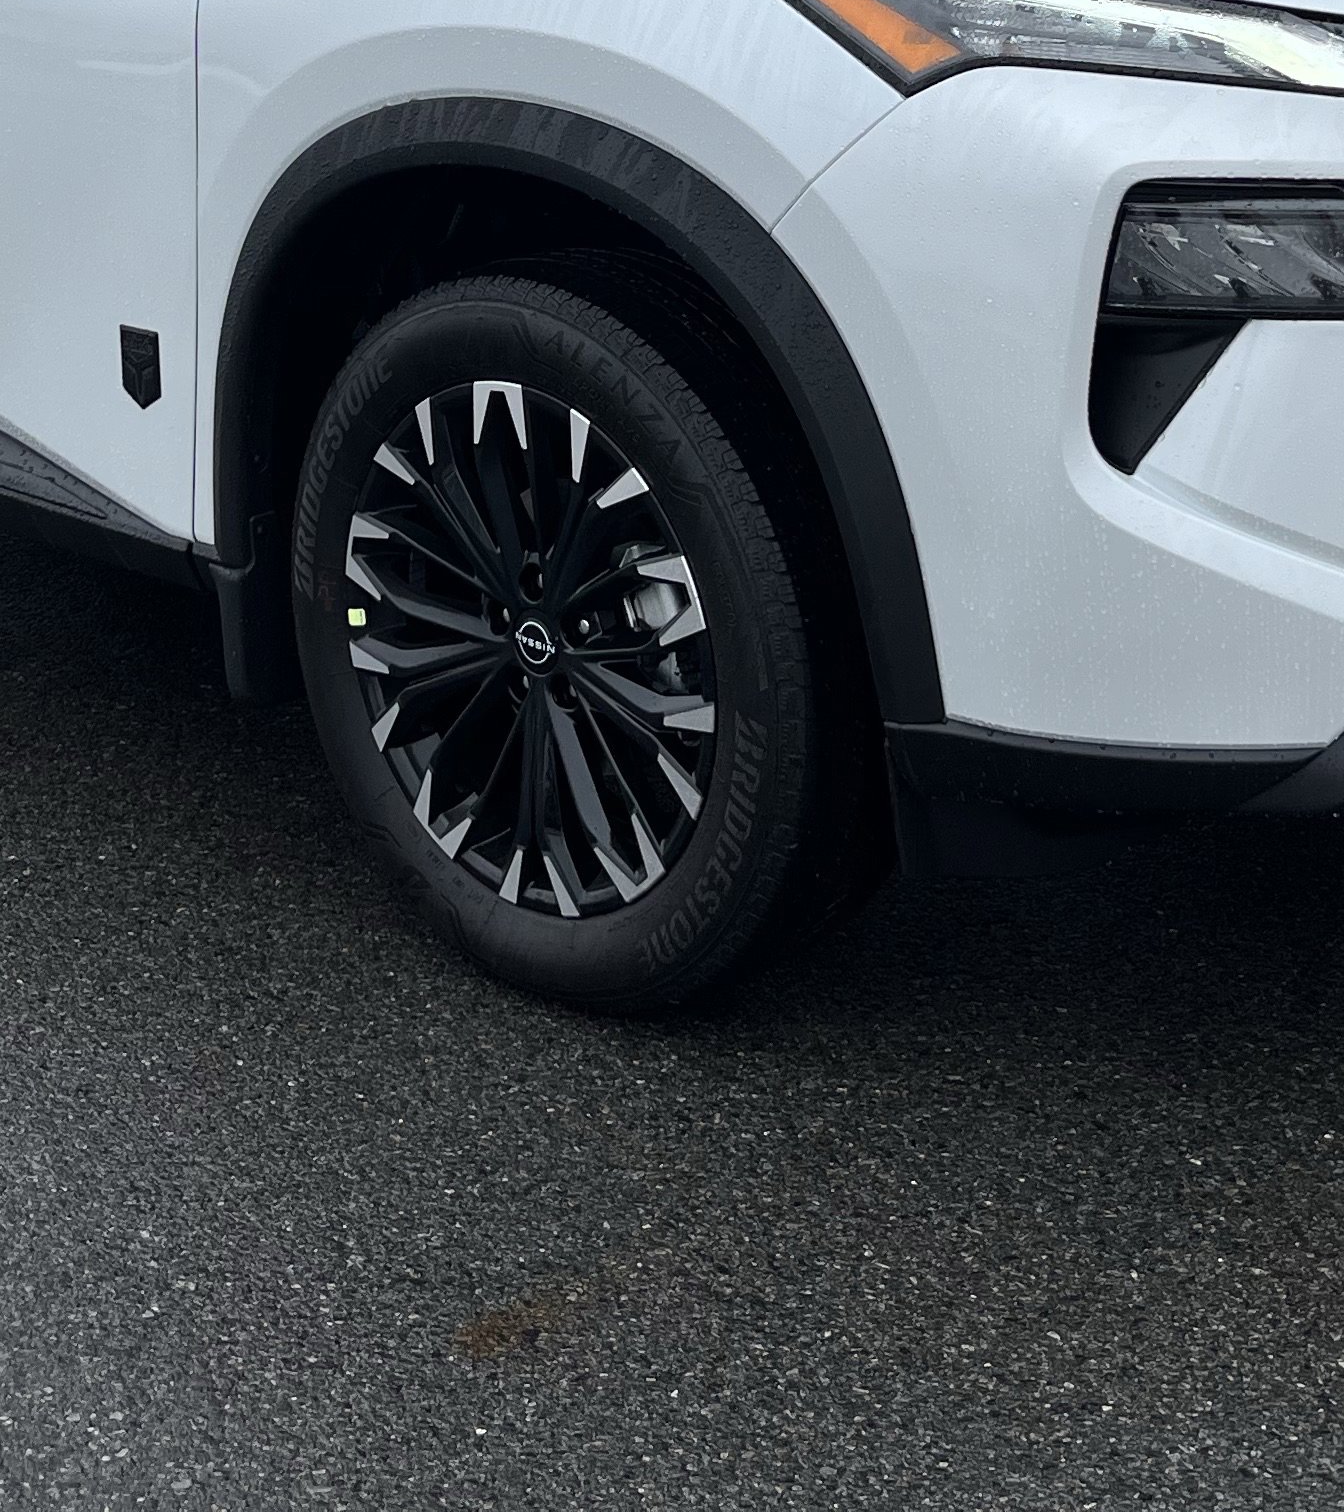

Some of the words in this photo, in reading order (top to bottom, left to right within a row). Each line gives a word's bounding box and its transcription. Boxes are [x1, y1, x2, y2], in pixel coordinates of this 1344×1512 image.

[294, 354, 393, 601] BRIDGESTONE
[544, 331, 681, 467] ALENZA
[639, 709, 770, 974] BRIDGESTONE
